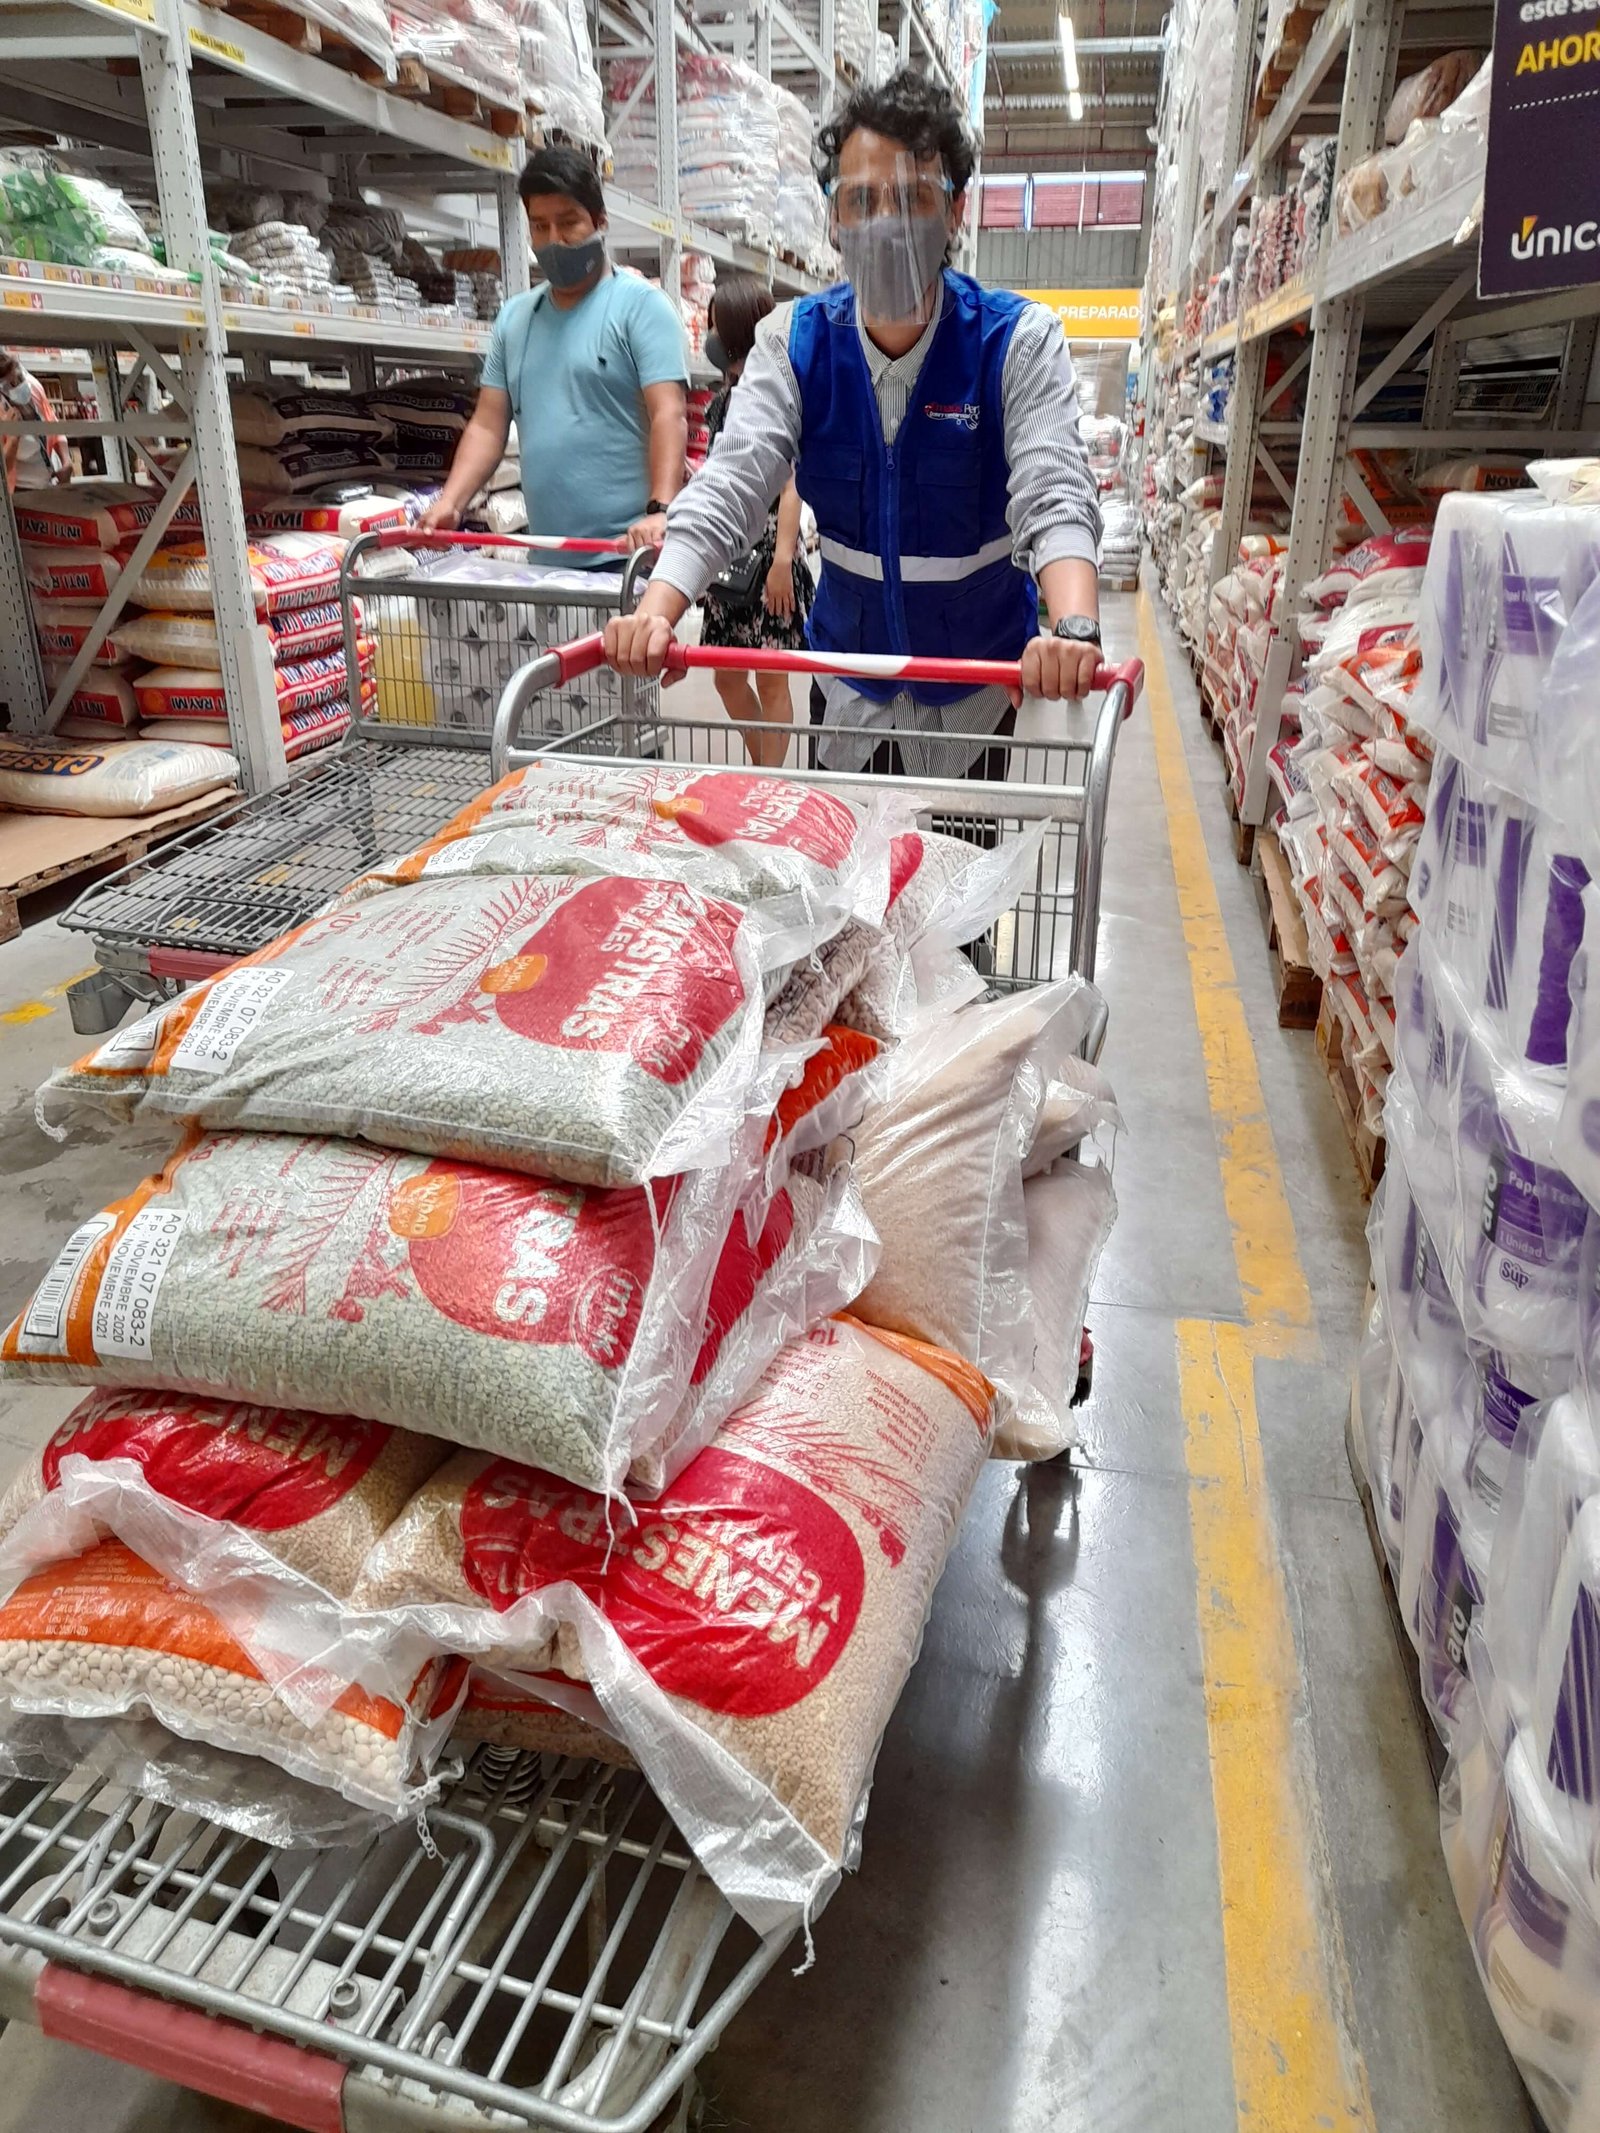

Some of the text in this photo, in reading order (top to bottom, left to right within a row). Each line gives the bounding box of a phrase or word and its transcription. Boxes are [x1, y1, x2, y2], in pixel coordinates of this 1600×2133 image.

[396, 453, 443, 466] ORTEÑO
[246, 512, 301, 529] AYMI
[192, 982, 234, 1031] NOVIEMBRE
[248, 985, 273, 1003] 321
[208, 984, 251, 1034] NOVIEMBRE
[238, 1007, 256, 1025] 07
[179, 1033, 198, 1054] 2021
[195, 1035, 215, 1057] 2020
[212, 1026, 245, 1060] 083-2
[1482, 1165, 1498, 1232] aro
[147, 1238, 170, 1266] 321
[1506, 1234, 1543, 1258] Unidad
[99, 1238, 134, 1309] NOVIEMBRE
[116, 1239, 150, 1311] NOVIEMBRE
[139, 1272, 157, 1294] 07
[97, 1312, 109, 1339] 2021
[113, 1314, 127, 1343] 2020
[130, 1298, 149, 1347] 083-2
[1447, 1604, 1467, 1664] aro
